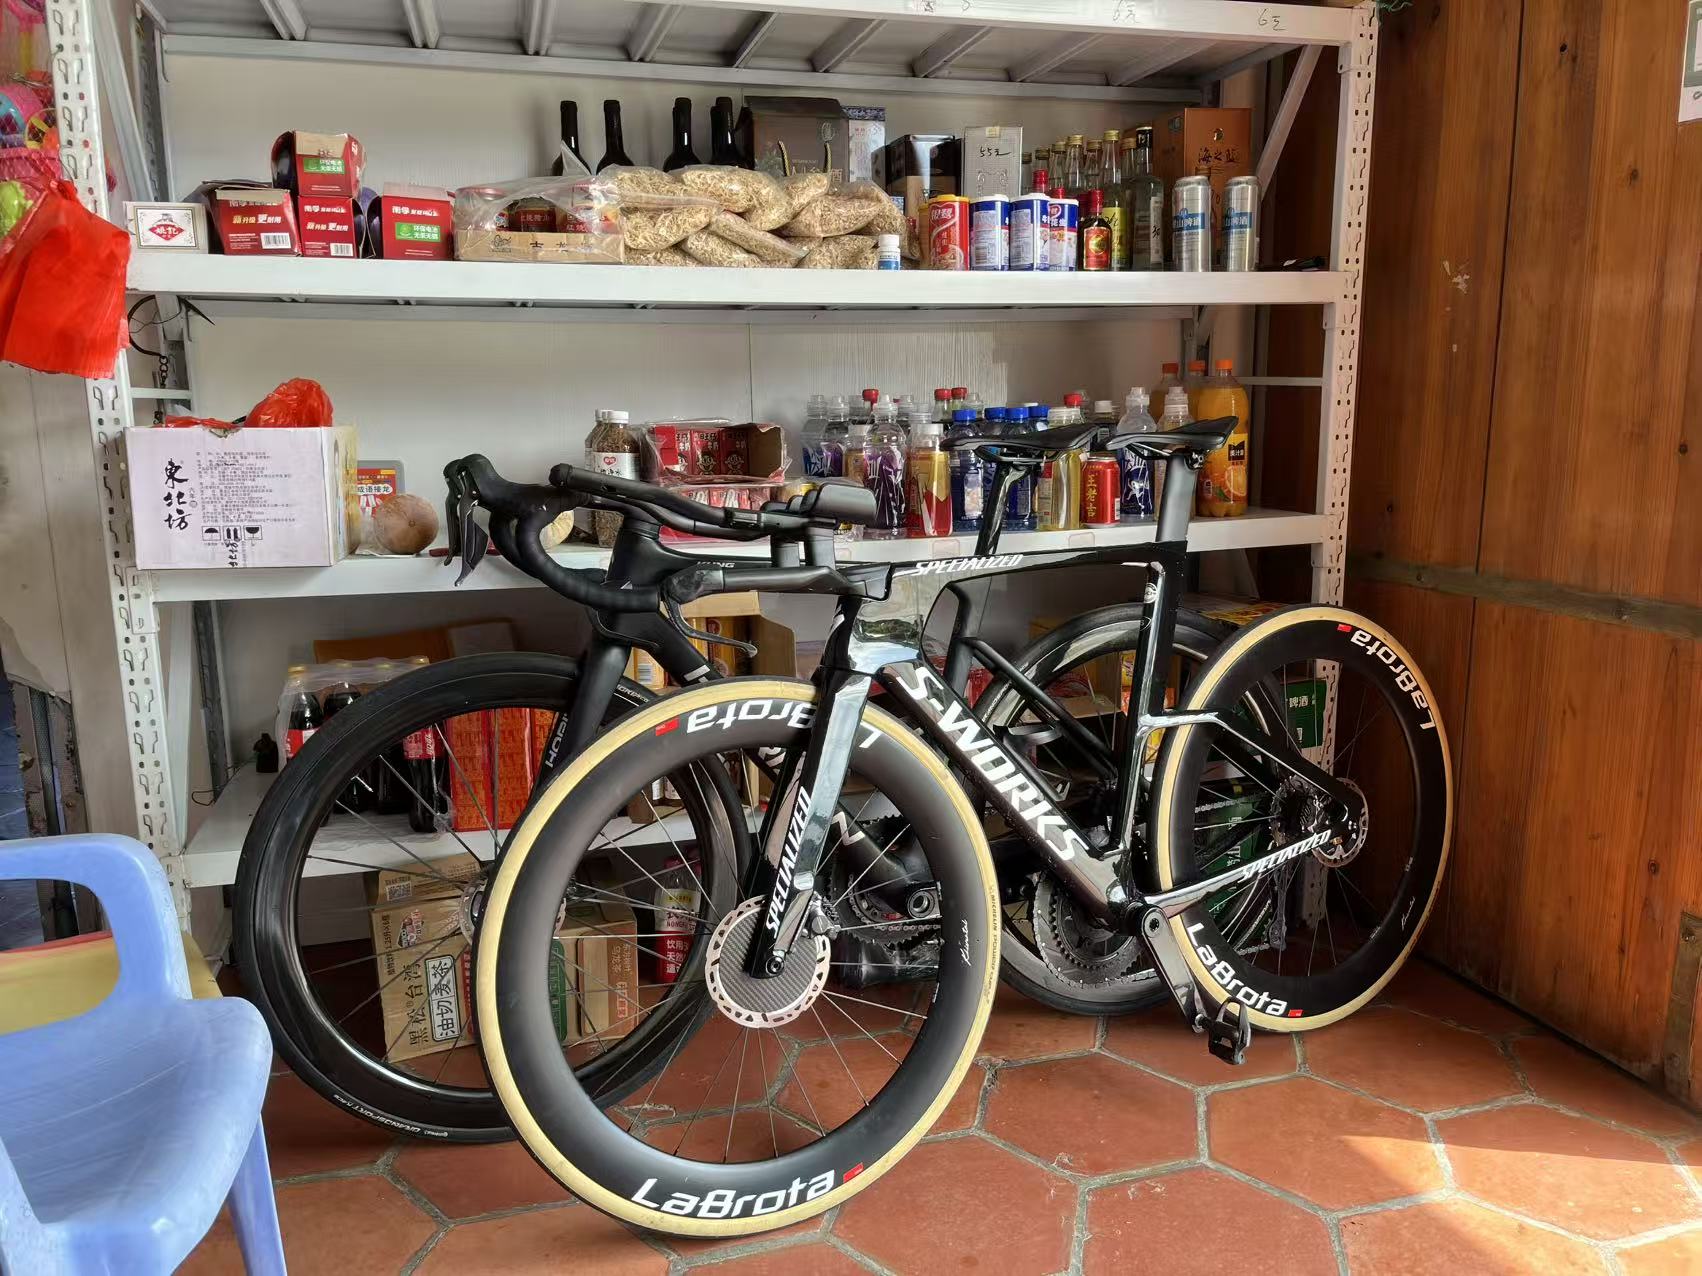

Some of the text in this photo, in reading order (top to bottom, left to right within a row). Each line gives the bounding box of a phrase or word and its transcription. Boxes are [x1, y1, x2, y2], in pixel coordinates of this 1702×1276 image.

[914, 554, 1024, 576] SPECIALIZED
[1350, 629, 1437, 730] LaBrota
[686, 698, 882, 749] LBrota
[897, 666, 1090, 861] S-WORKS
[765, 786, 812, 939] SPECIALIZED
[1237, 829, 1332, 883] SPECIALIZED
[432, 960, 457, 1036] 油切麦茶
[1185, 922, 1288, 1017] LaBrota
[631, 1169, 836, 1218] LaBrota
